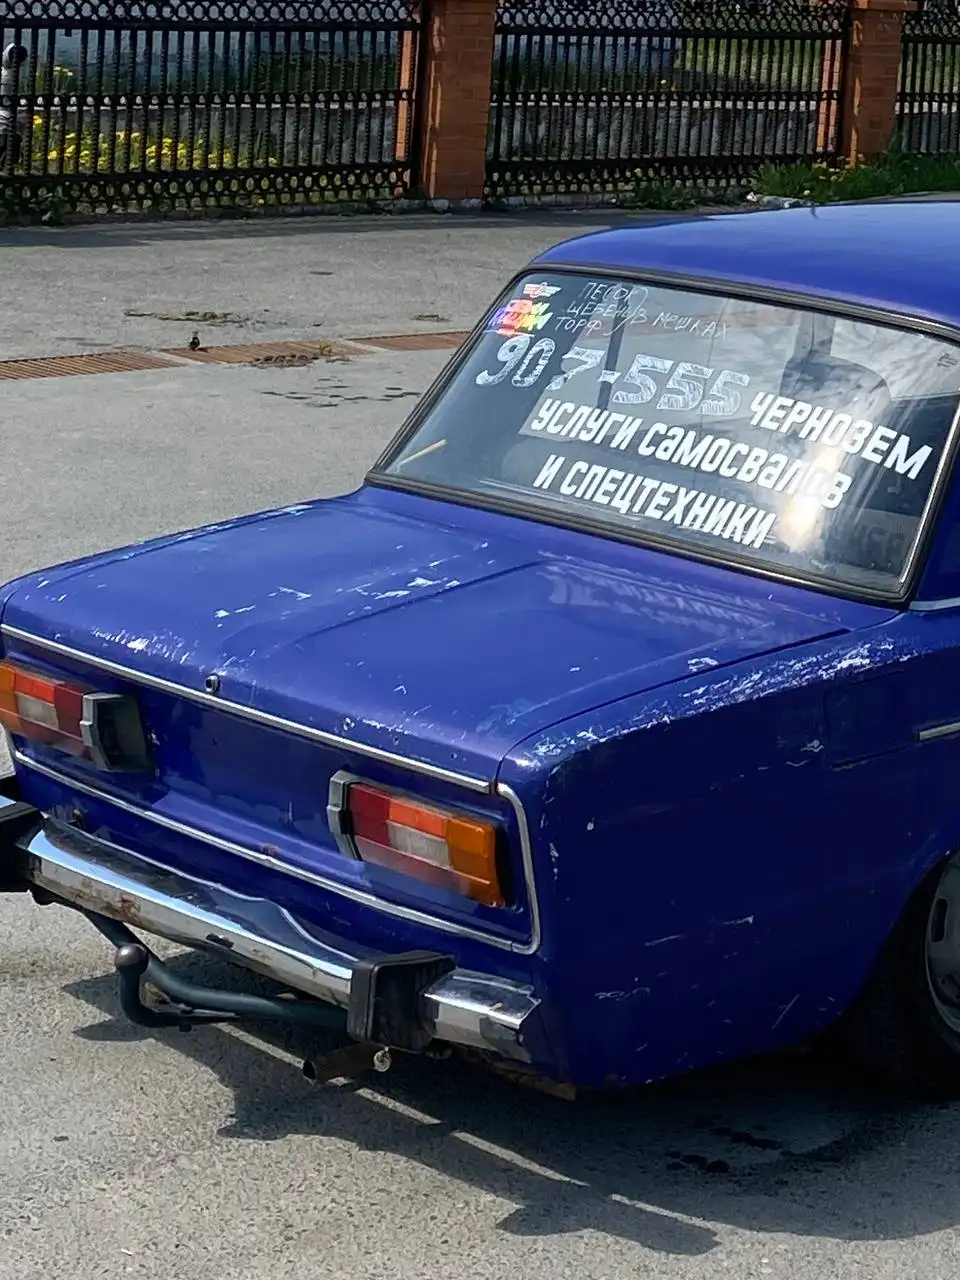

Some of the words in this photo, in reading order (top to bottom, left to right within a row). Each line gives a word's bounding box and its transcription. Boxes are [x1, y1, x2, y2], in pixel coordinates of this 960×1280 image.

[554, 316, 603, 336] ТОРФ
[531, 398, 644, 451] УСЛУГИ
[750, 391, 933, 480] ЧЕРНОЗЕМ
[532, 455, 566, 490] И
[559, 461, 778, 550] СПЕЦТЕХНИКИ
